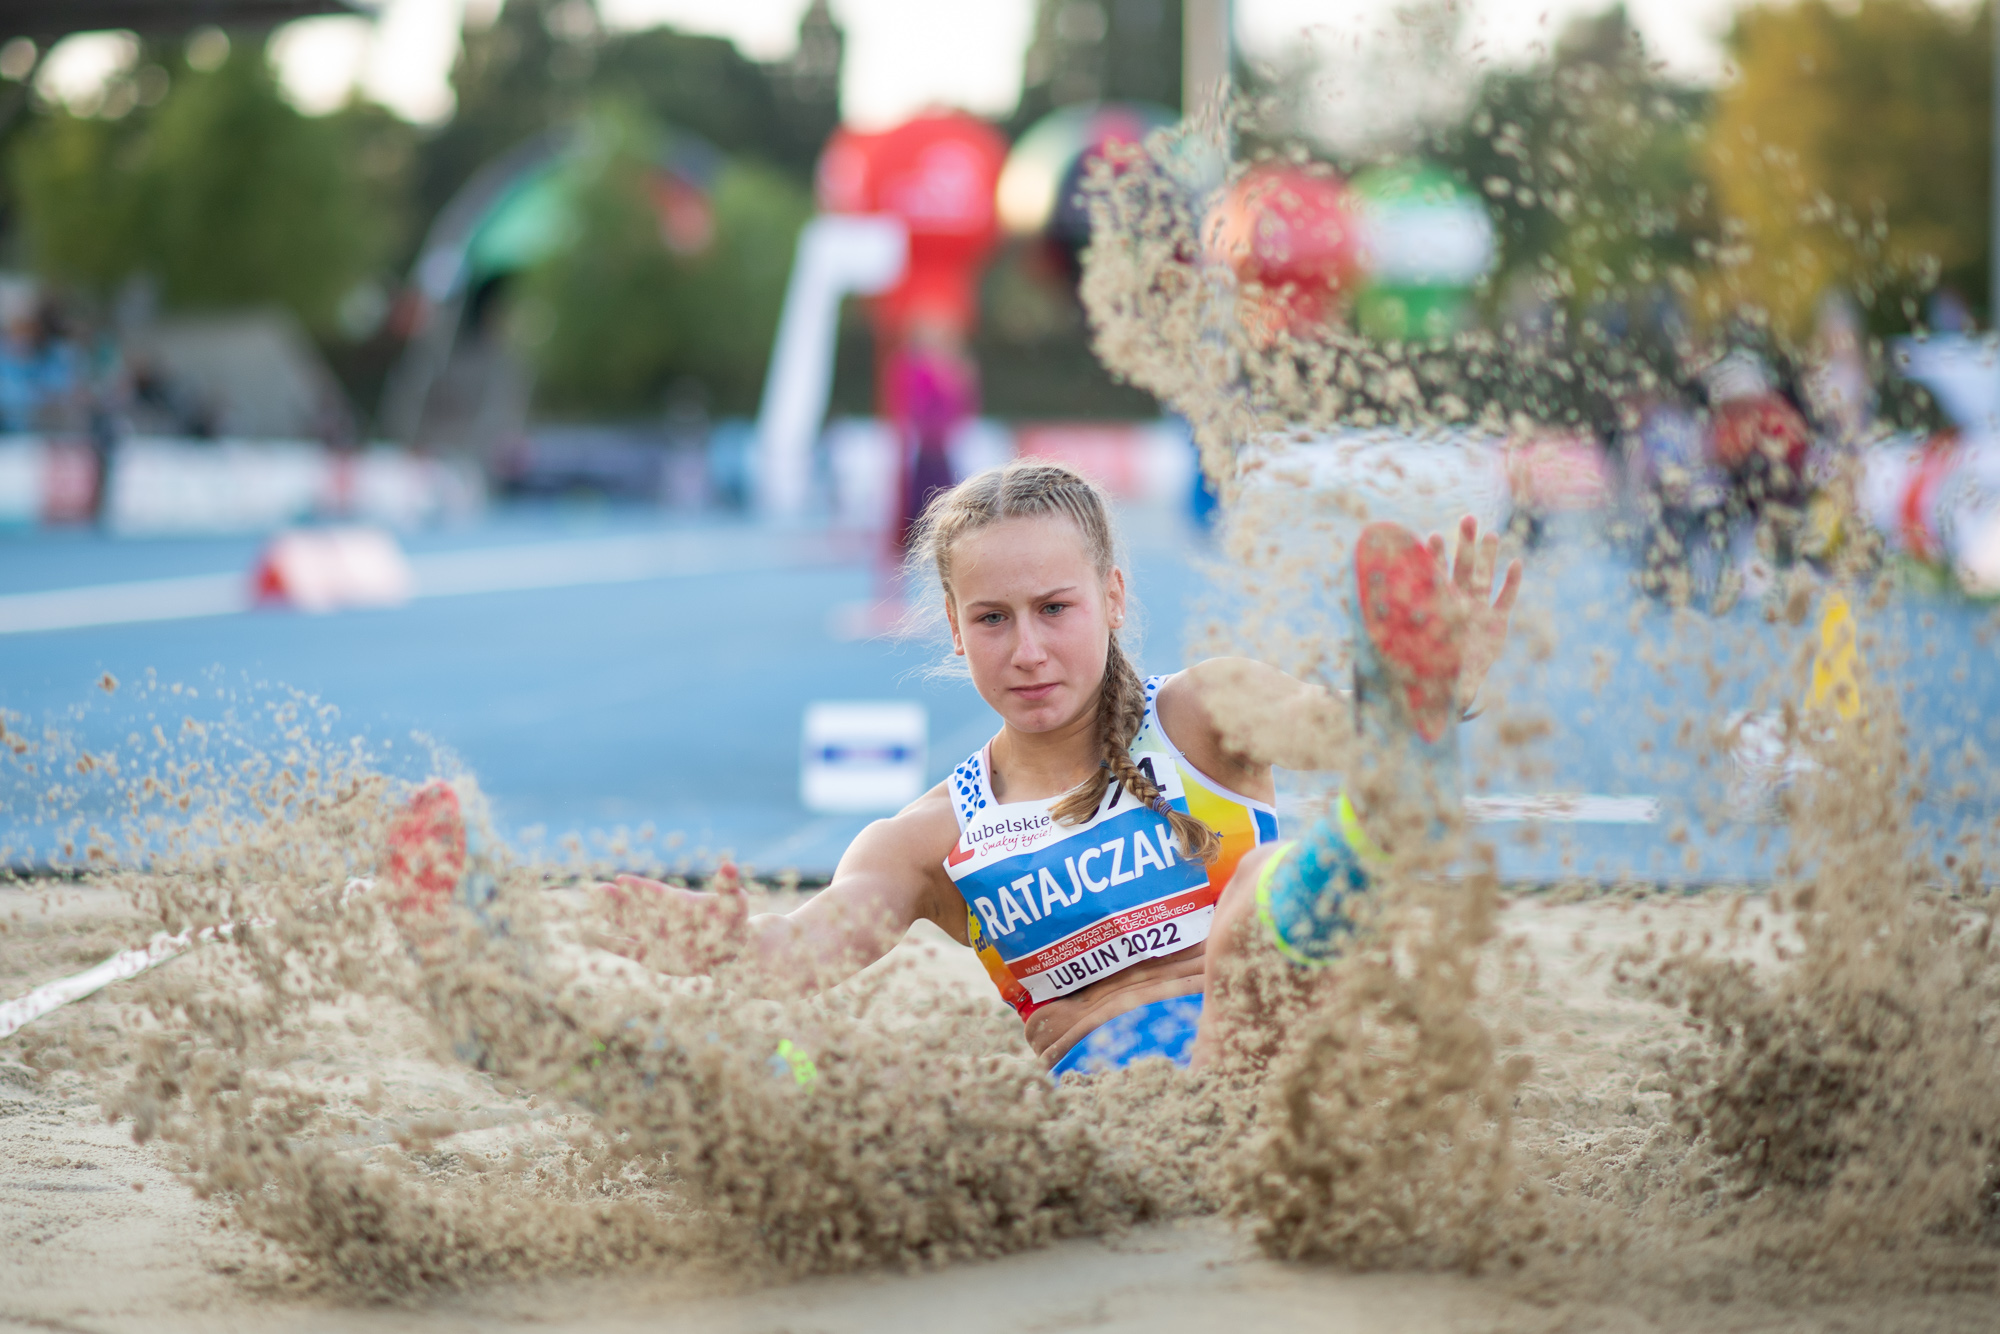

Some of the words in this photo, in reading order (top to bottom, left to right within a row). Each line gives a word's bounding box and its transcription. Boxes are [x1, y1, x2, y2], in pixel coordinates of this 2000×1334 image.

[966, 815, 1050, 845] lubelskie
[981, 834, 1020, 857] Smakuj
[1021, 825, 1053, 848] życie!
[974, 823, 1193, 940] RATAJCZAK
[1037, 948, 1058, 962] PZLA
[1057, 921, 1114, 952] MISTRZOSTWA
[1113, 910, 1148, 926] POLSKI
[1148, 903, 1167, 915] U16
[1085, 927, 1120, 949] JANUSZA
[1046, 943, 1120, 990] LUBLIN
[1121, 922, 1182, 958] 2022
